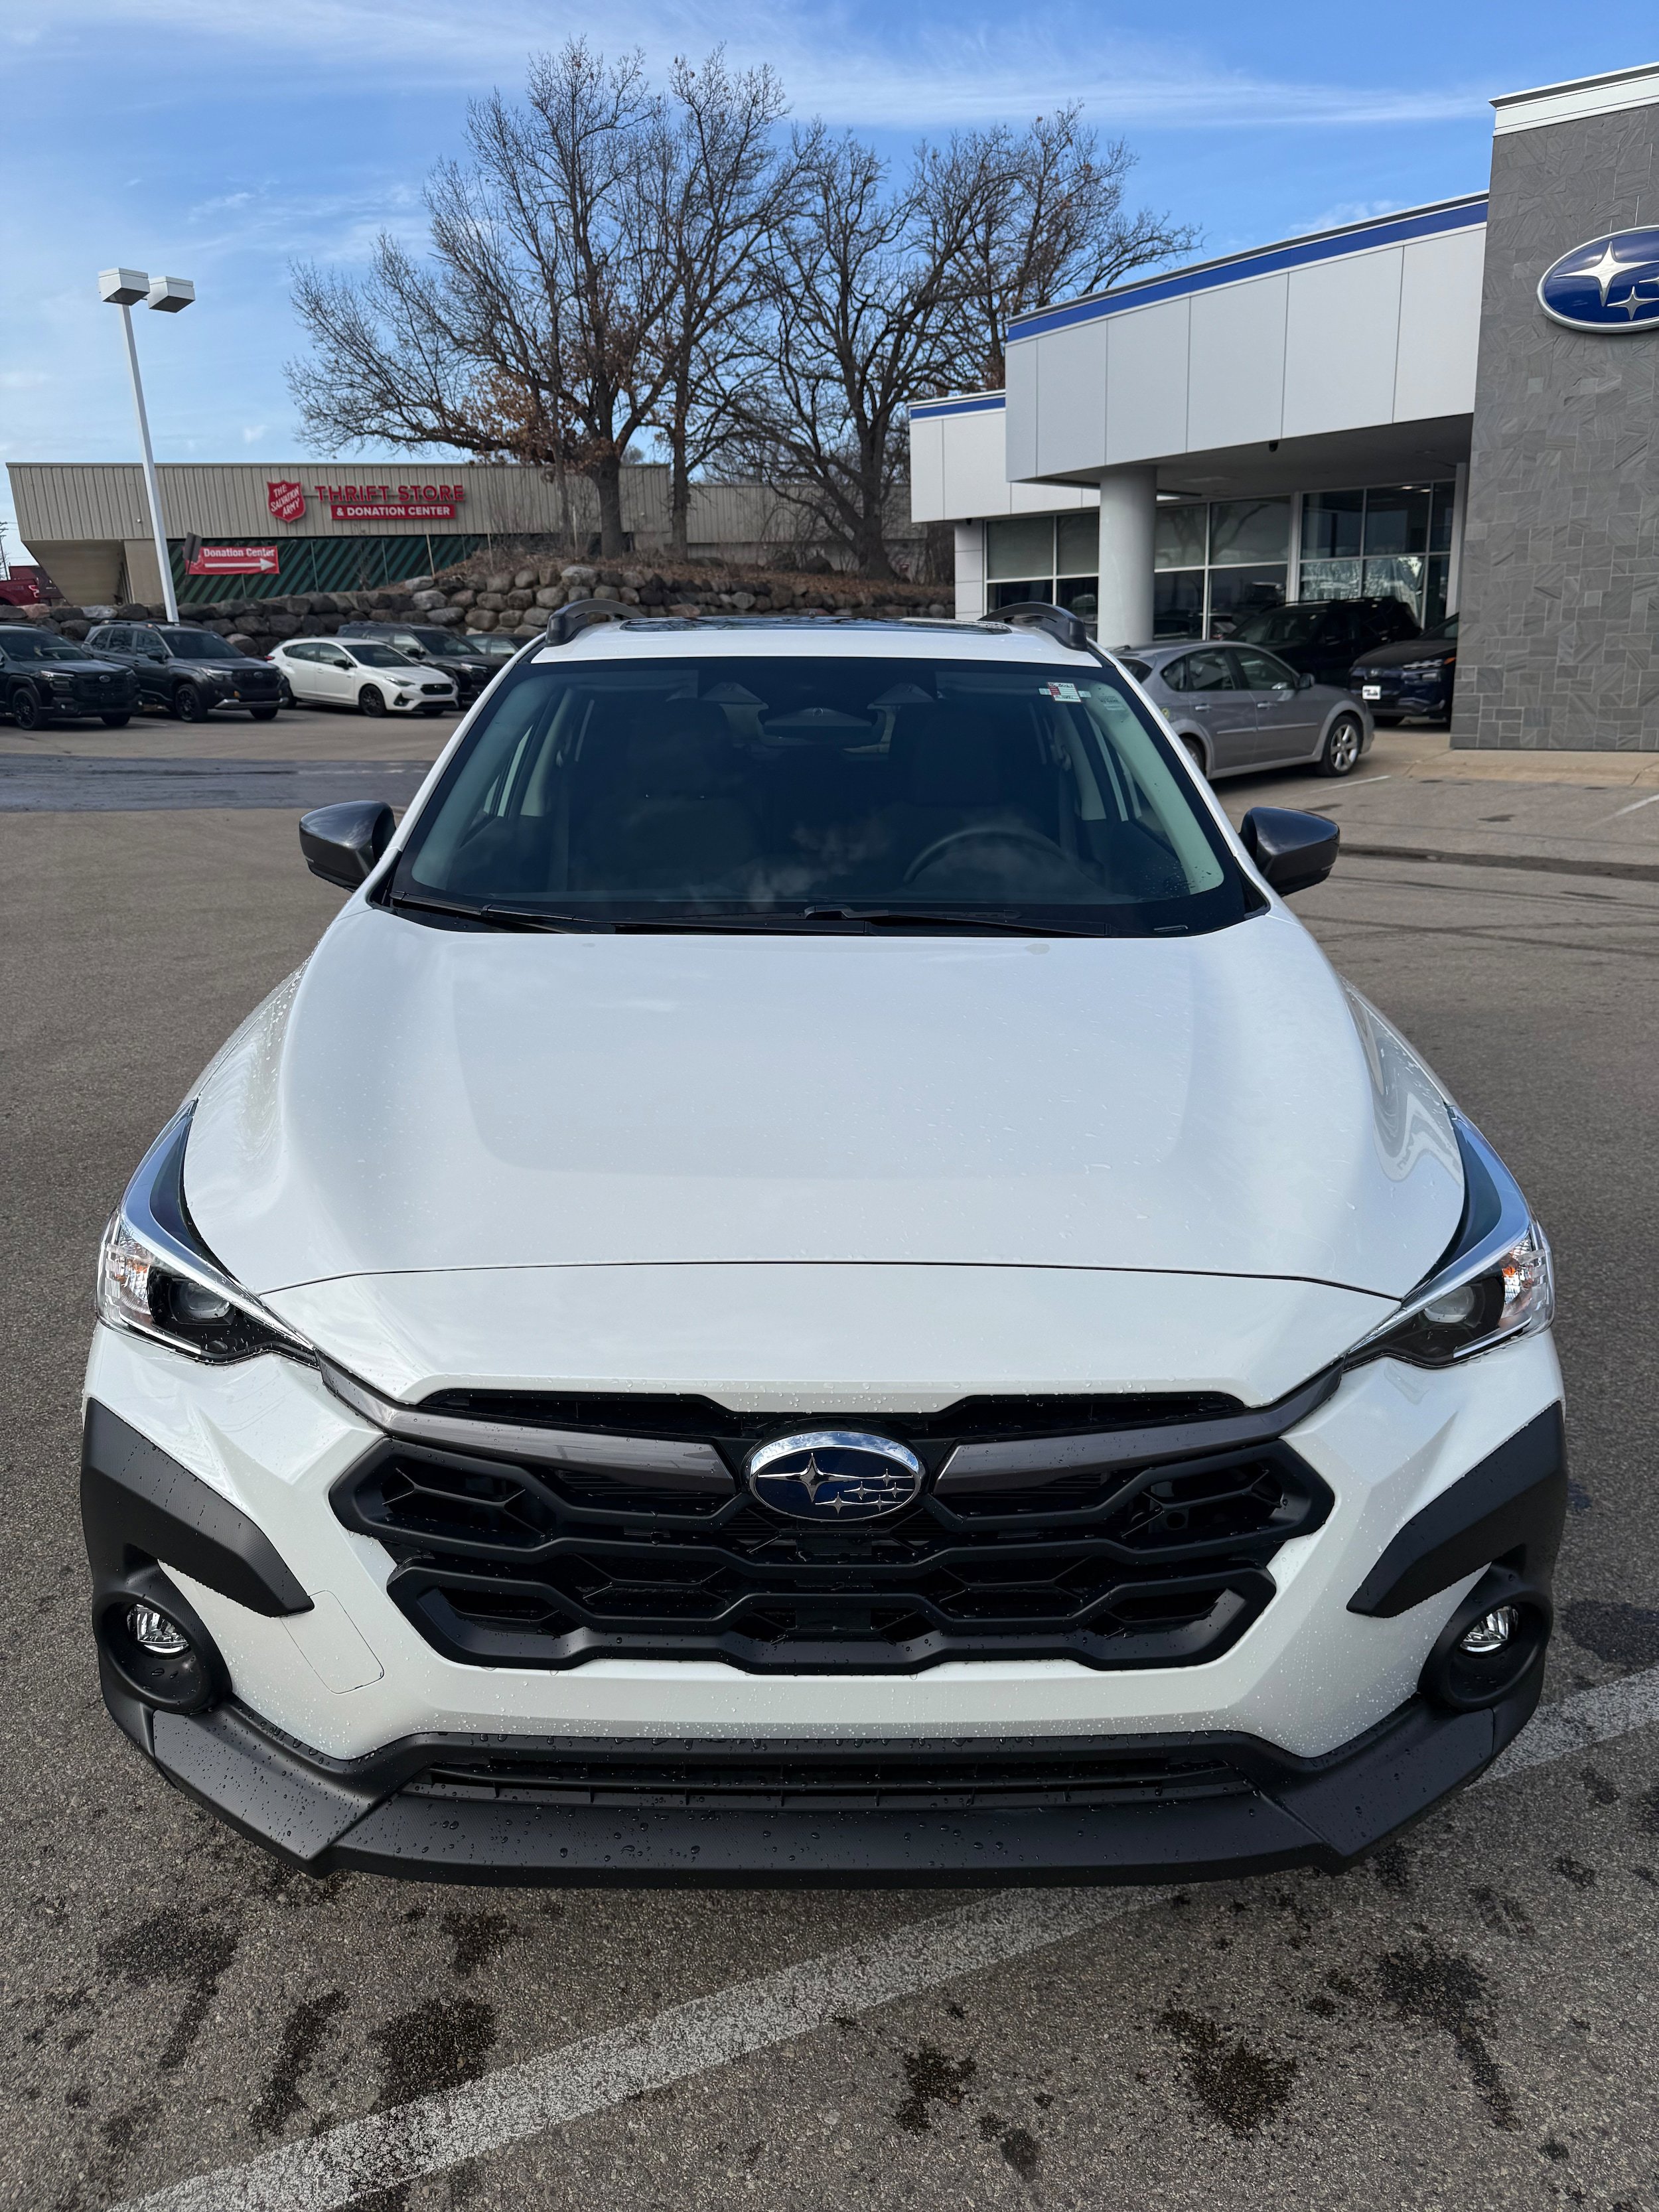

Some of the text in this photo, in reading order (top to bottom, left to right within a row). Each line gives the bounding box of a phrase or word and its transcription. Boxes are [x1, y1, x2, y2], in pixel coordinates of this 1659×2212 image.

[270, 485, 300, 512] SALVATION
[273, 484, 287, 498] THE
[315, 485, 464, 502] THRIFT STORE
[282, 497, 299, 518] ARMY
[336, 506, 450, 516] & DONATION CENTER
[203, 548, 275, 557] Donation Center
